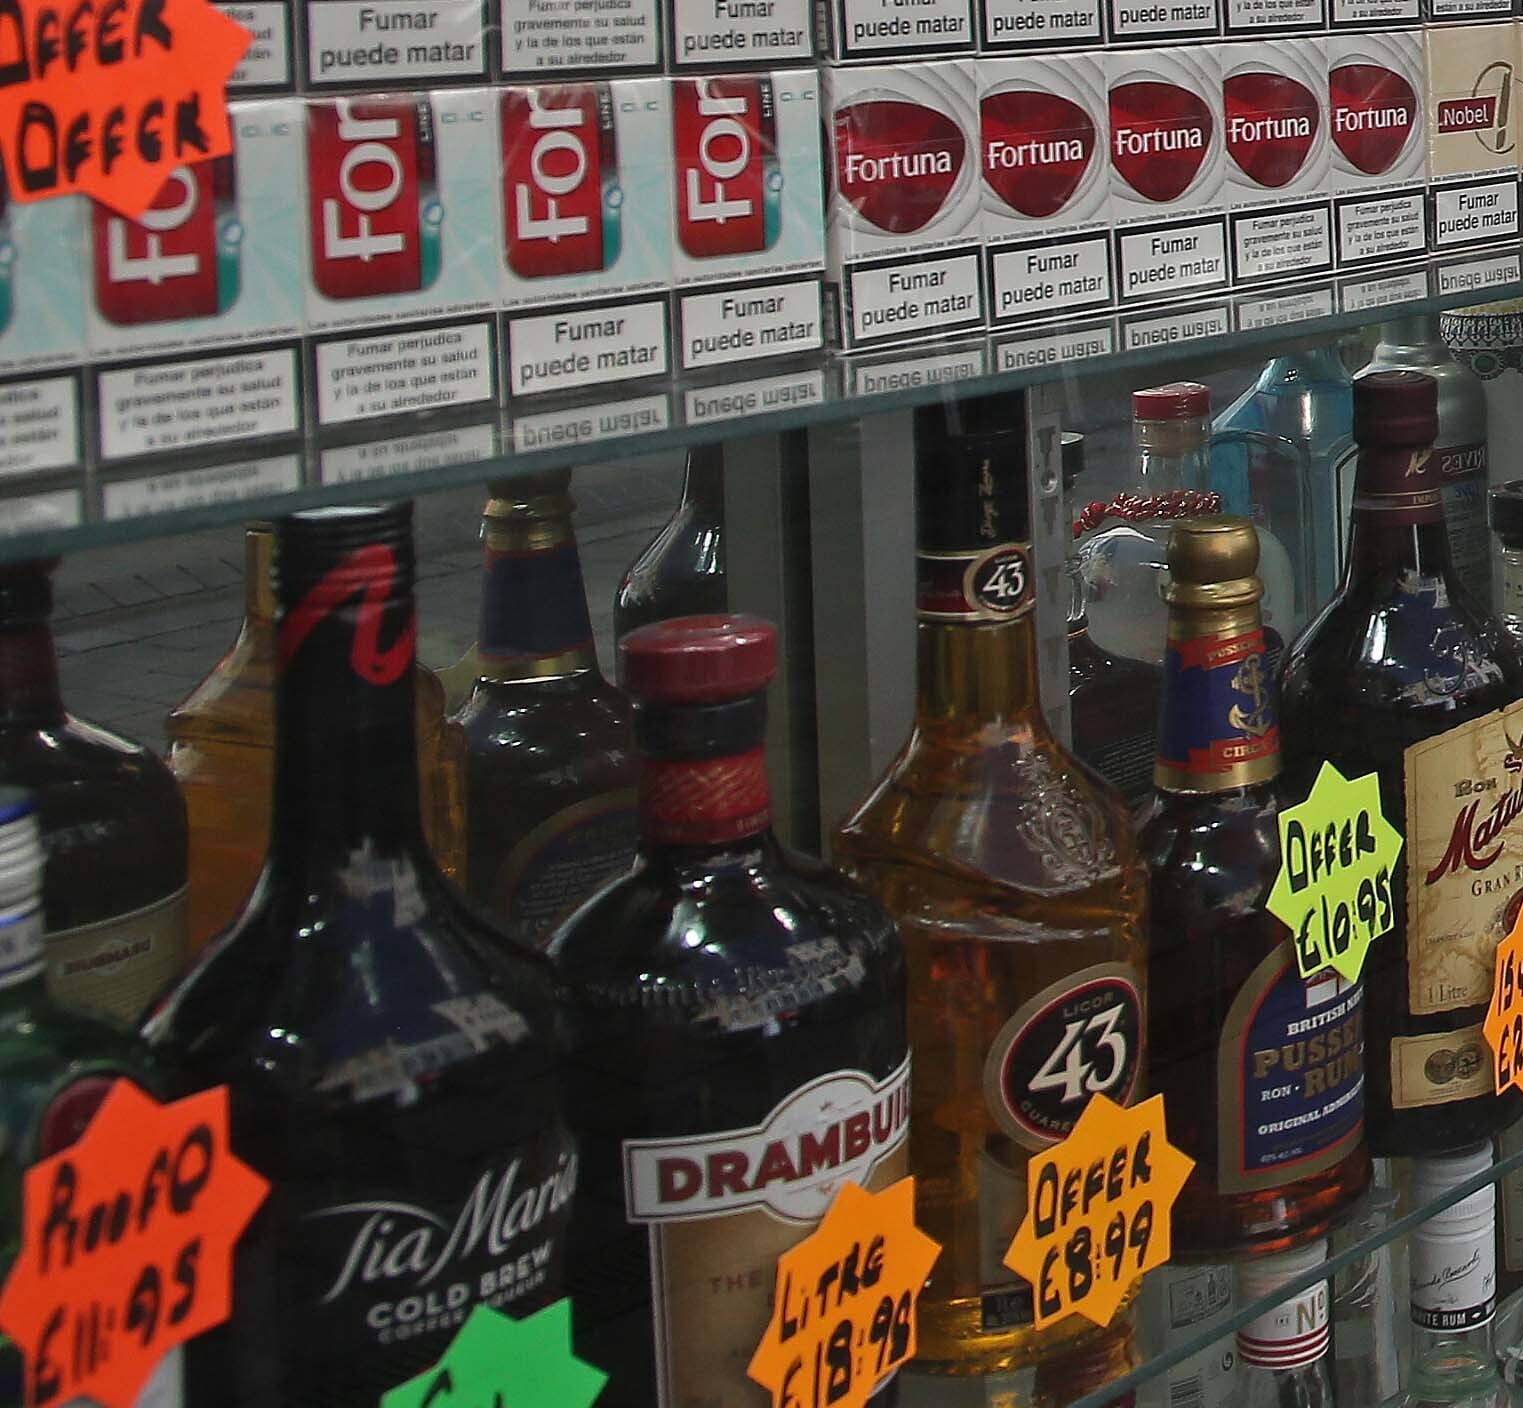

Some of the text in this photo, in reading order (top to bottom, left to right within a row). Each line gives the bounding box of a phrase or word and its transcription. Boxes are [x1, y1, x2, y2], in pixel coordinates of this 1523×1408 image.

[18, 90, 210, 191] OFFER
[988, 138, 1083, 171] Fortuna
[846, 148, 952, 184] Fortuna
[983, 560, 1024, 598] 43
[1285, 808, 1376, 894] OFFER
[1471, 873, 1511, 898] GRAN
[1287, 1002, 1346, 1037] BRITISH
[1027, 1005, 1128, 1100] 43
[1252, 1012, 1362, 1080] PUSSE
[1260, 1083, 1292, 1103] RON
[1257, 1109, 1322, 1136] ORIGINAL
[1034, 1130, 1153, 1238] OFFER
[366, 1282, 471, 1329] COLD
[479, 1239, 553, 1297] BREW
